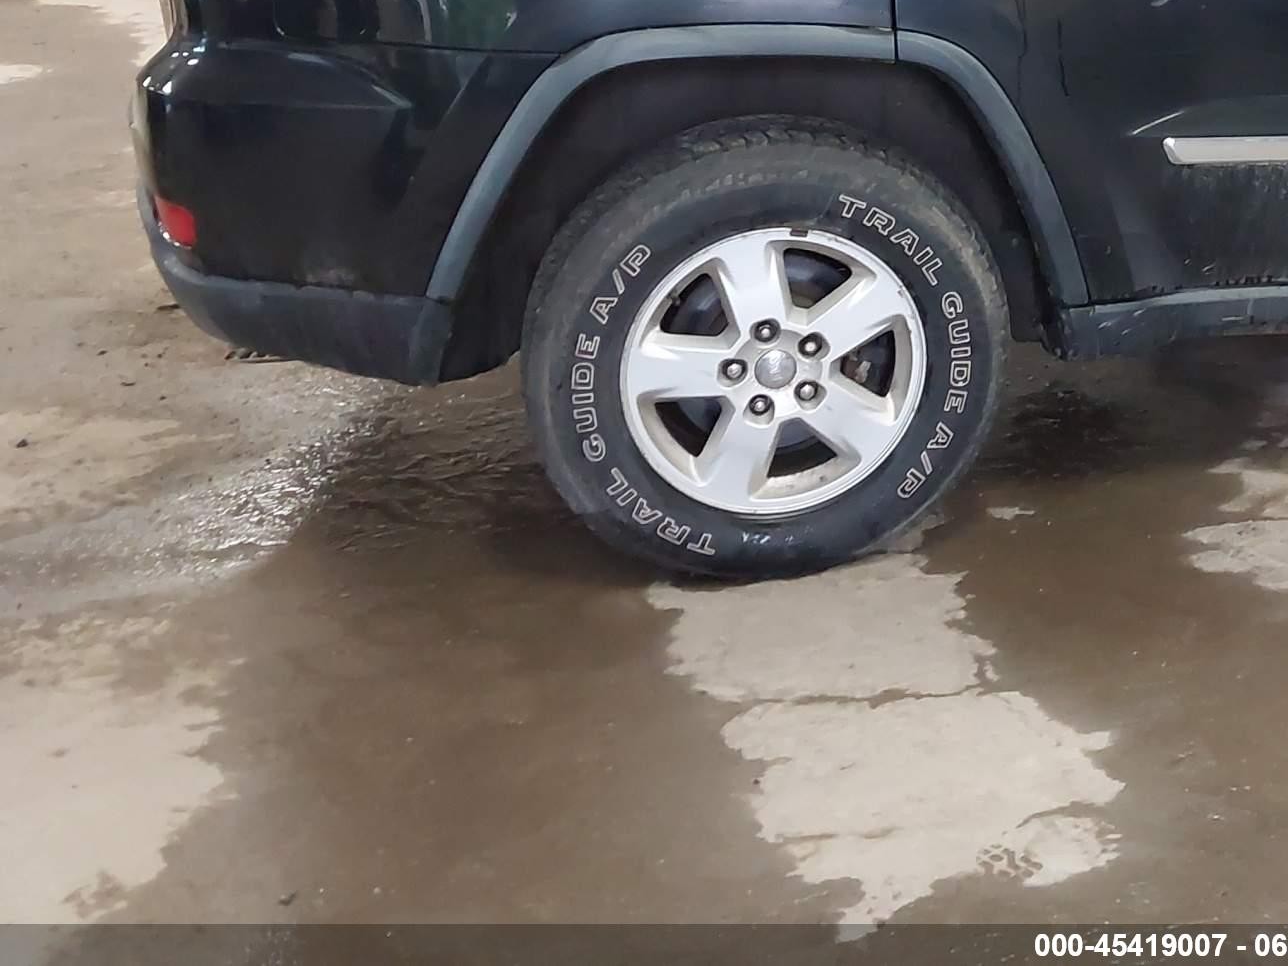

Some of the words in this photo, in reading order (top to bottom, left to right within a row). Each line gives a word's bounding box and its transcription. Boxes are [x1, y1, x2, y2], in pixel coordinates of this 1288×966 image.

[590, 244, 651, 325] A/P
[839, 195, 943, 286] TRAIL
[571, 333, 607, 463] GUIDE
[941, 292, 972, 414] GUIDE
[897, 422, 955, 499] A/P
[606, 466, 716, 556] TRAIL
